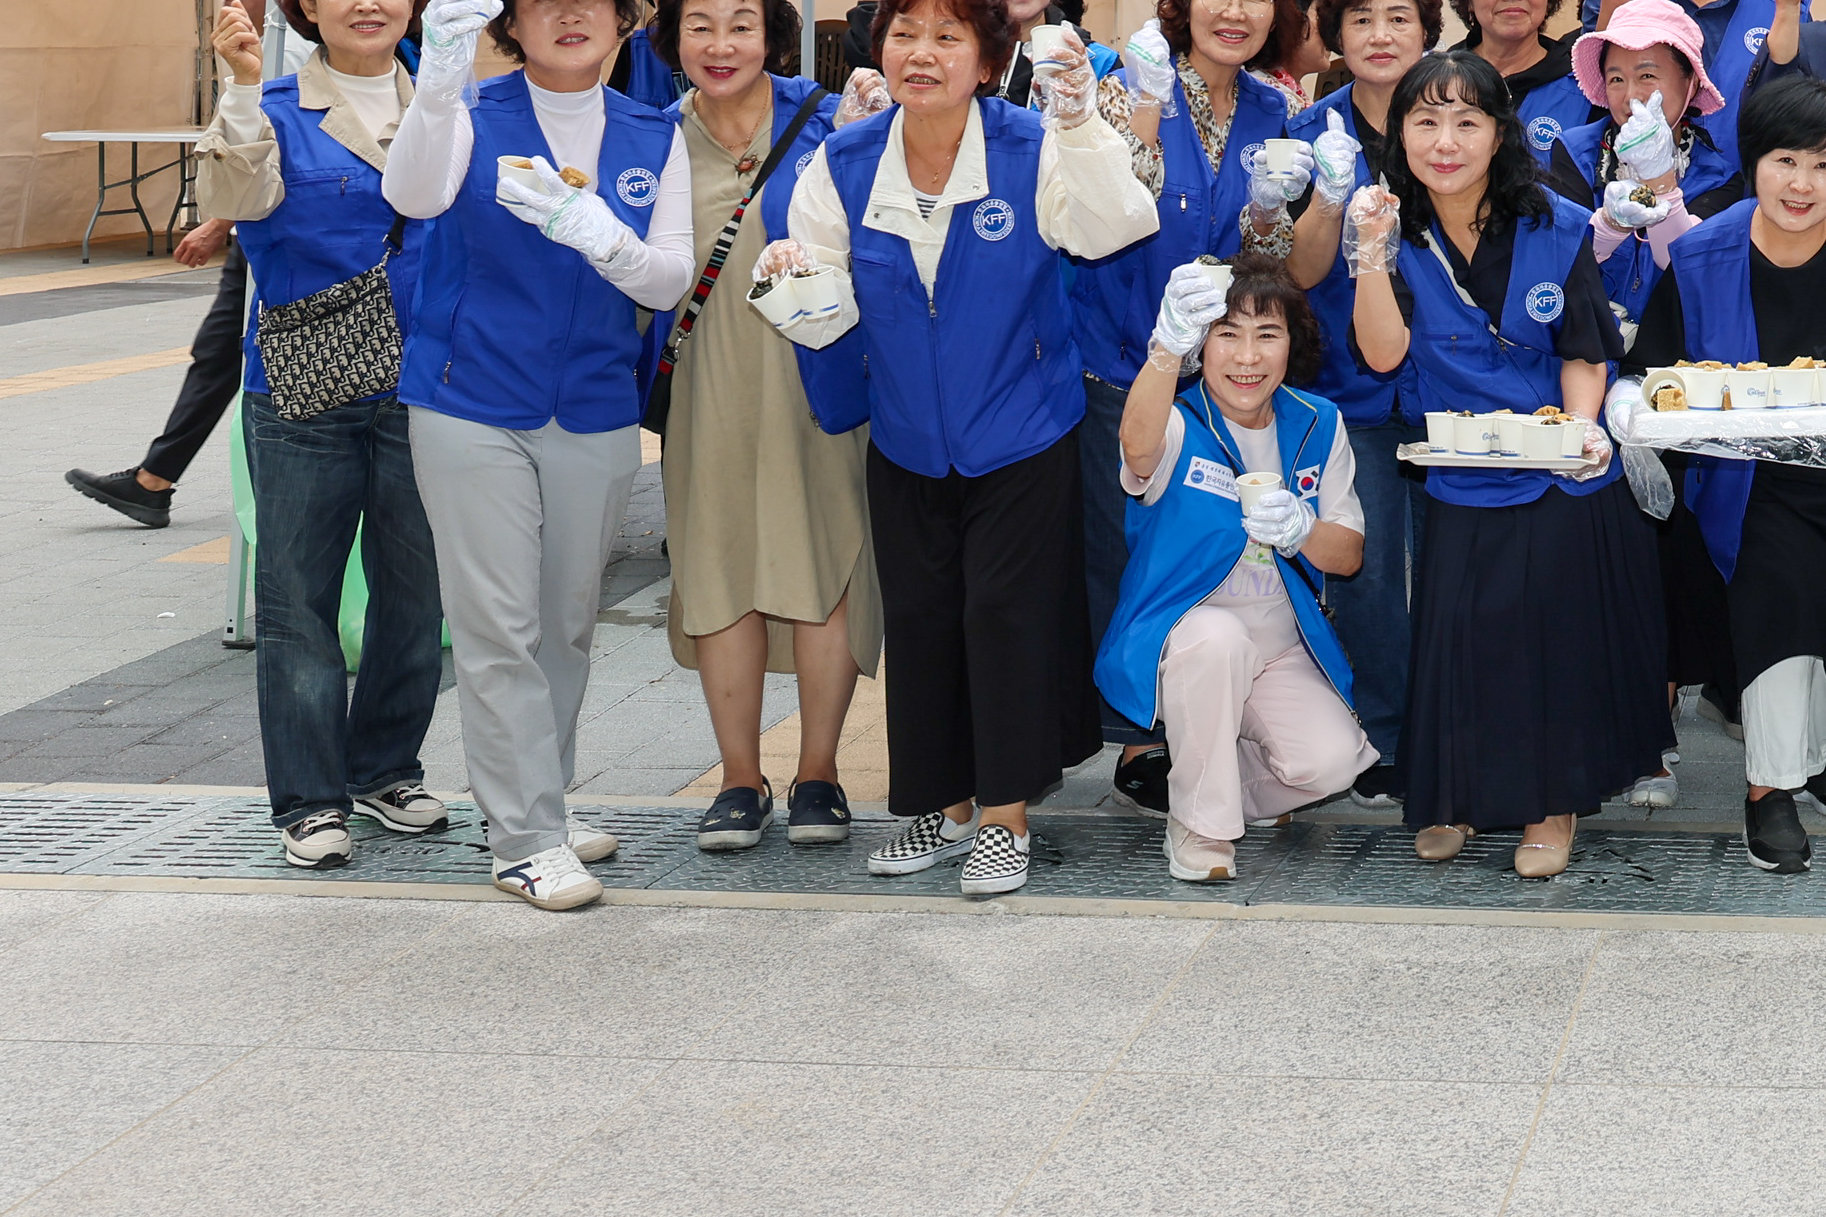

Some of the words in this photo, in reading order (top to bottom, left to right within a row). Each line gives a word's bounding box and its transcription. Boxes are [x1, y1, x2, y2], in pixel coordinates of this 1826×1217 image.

[1534, 125, 1556, 139] KFF
[626, 180, 650, 193] KFF
[982, 212, 1007, 226] KFF
[1534, 295, 1558, 308] KFF
[1205, 474, 1239, 491] 한국자유총연
